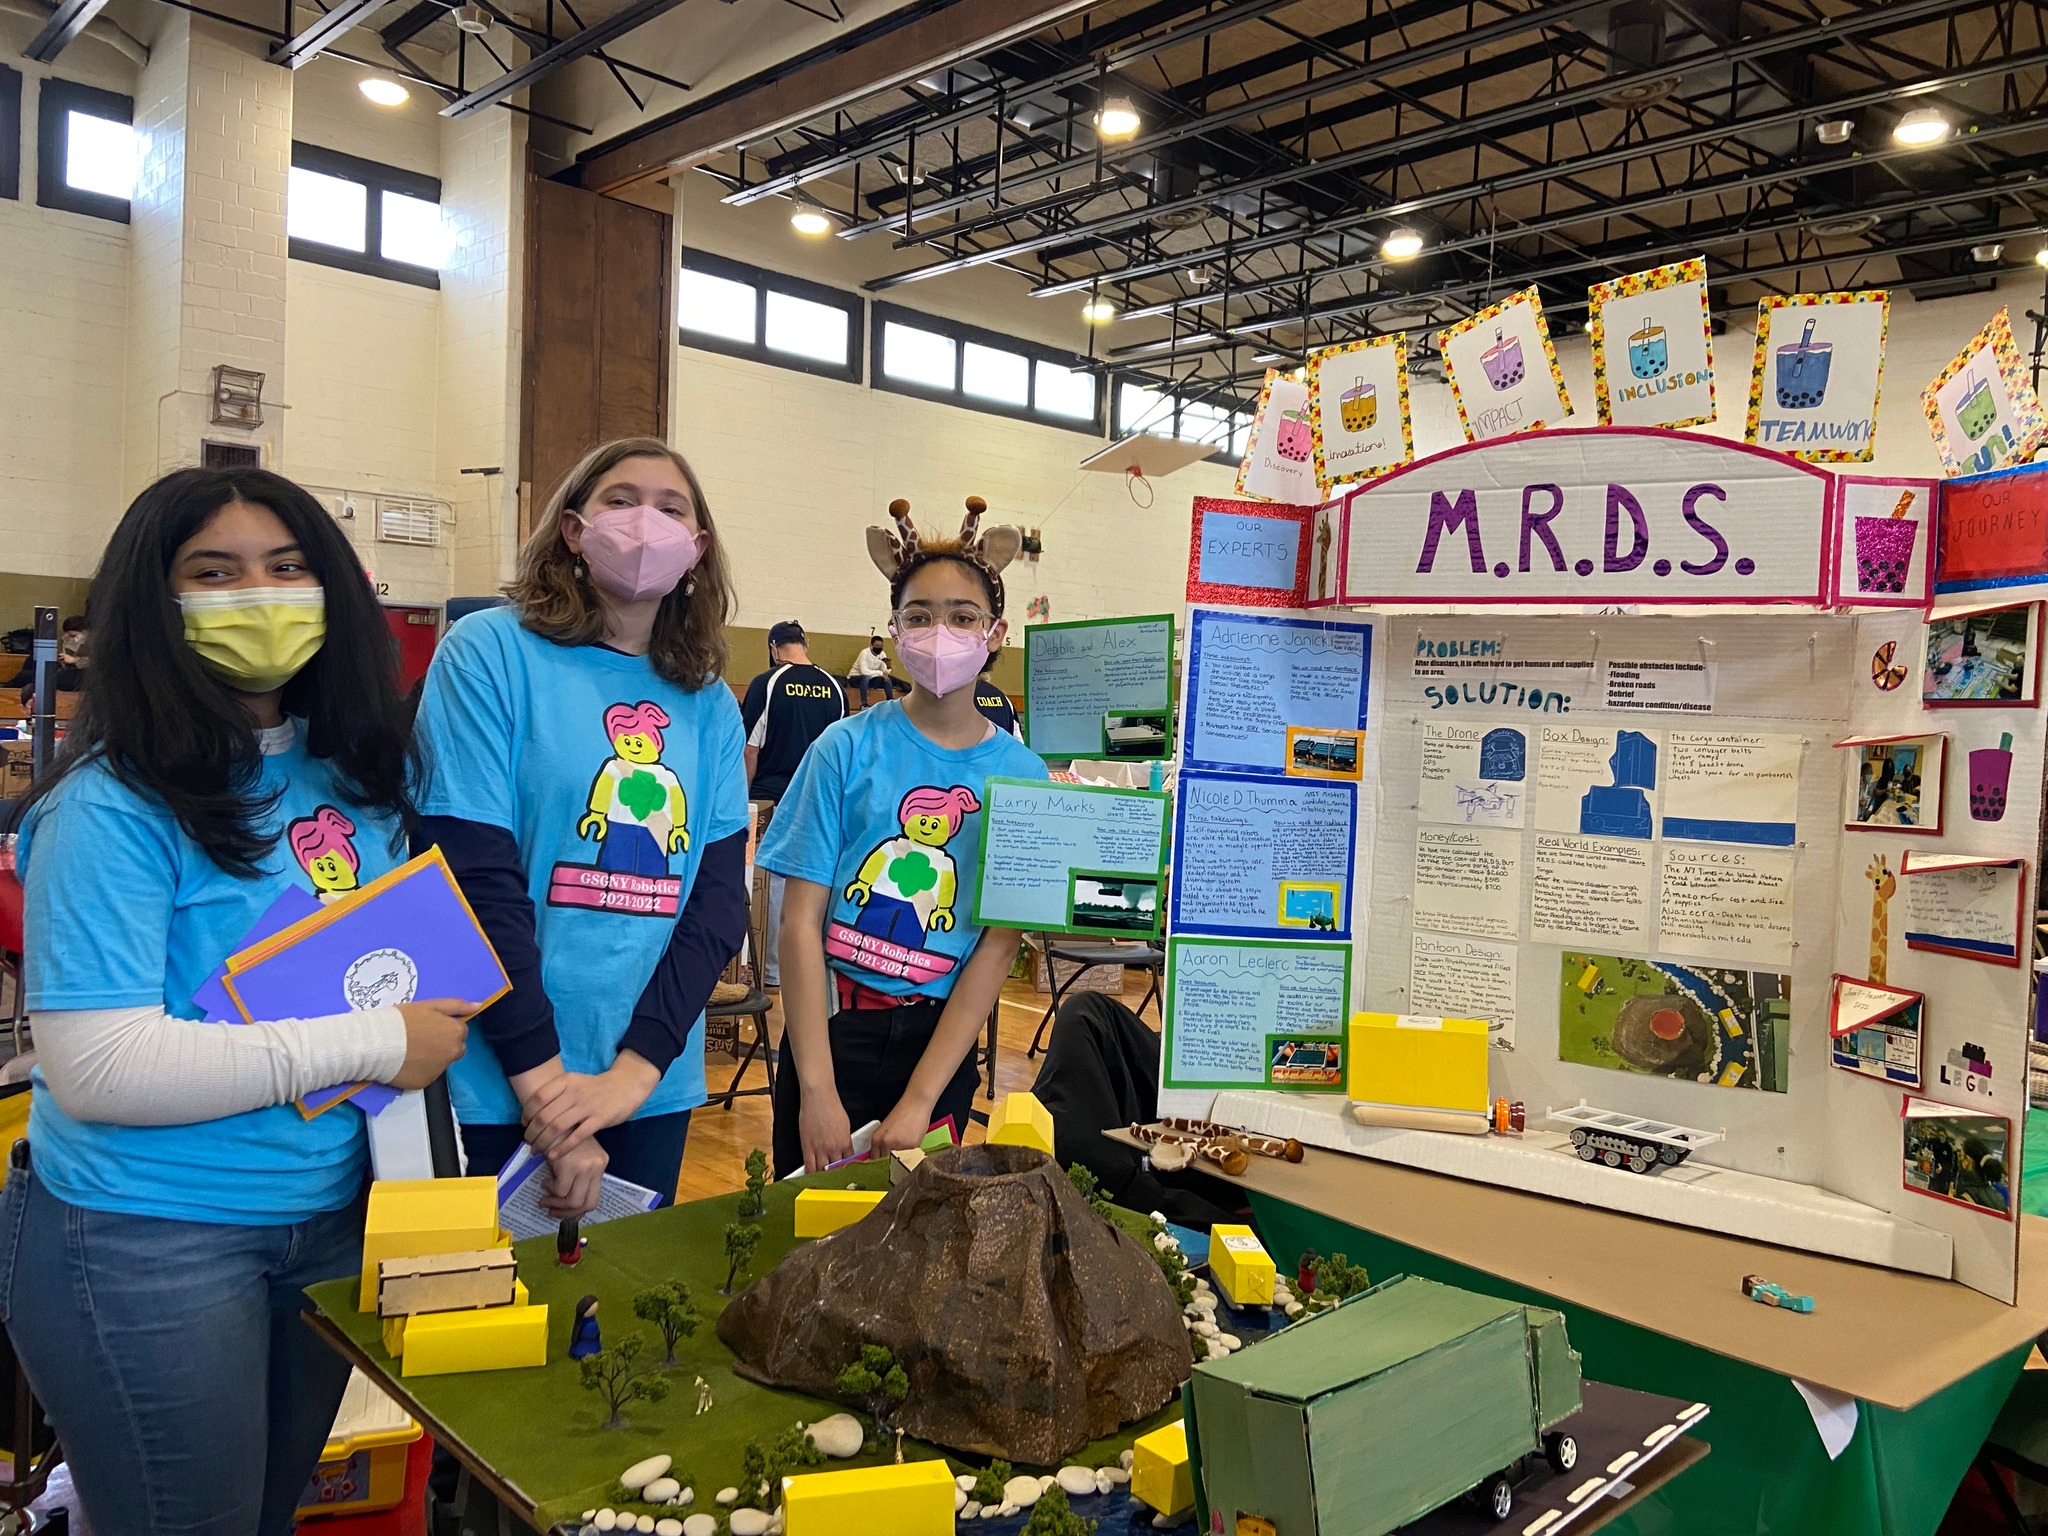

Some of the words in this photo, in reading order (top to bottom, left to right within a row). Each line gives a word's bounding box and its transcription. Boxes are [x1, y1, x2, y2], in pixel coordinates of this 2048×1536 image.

[1618, 369, 1708, 402] INCLUSION
[1472, 397, 1523, 439] IMPACT
[1264, 457, 1303, 478] Discovery
[1983, 491, 2010, 508] OUR
[1236, 521, 1262, 532] OUR
[1416, 483, 1755, 578] M.R.D.S.
[1953, 509, 2041, 542] JOURNEY
[1208, 540, 1288, 560] EXPERTS
[1035, 635, 1075, 657] Debbie
[1081, 641, 1092, 651] and
[1104, 630, 1136, 649] Alex
[1211, 625, 1280, 646] Adrienne
[1284, 632, 1333, 648] Janicki
[1417, 639, 1501, 658] PROBLEM:
[1608, 661, 1638, 669] Possible
[1639, 662, 1674, 670] obstacles
[1608, 671, 1640, 679] -Flooding
[785, 682, 831, 699] COACH
[1424, 682, 1572, 714] SOLUTION:
[976, 696, 1003, 707] COACH
[1606, 700, 1644, 708] -hazardous
[1645, 702, 1712, 711] condition/disease
[1425, 725, 1442, 738] The
[1448, 726, 1480, 739] Drone
[1542, 728, 1568, 741] Box
[1572, 729, 1610, 748] Design:
[1690, 735, 1712, 745] Cargo
[1717, 735, 1764, 744] container:
[993, 790, 1038, 815] Larry
[1047, 796, 1096, 814] Marks
[1191, 787, 1229, 804] Nicole
[1234, 790, 1242, 805] D
[1246, 789, 1298, 807] Thumma
[1211, 815, 1248, 827] takeaways
[1420, 832, 1479, 843] Money/Cost:
[1538, 837, 1559, 846] Real
[1562, 838, 1588, 850] World
[1593, 842, 1641, 856] Examples:
[1669, 849, 1745, 865] Sources:
[1664, 865, 1680, 873] The
[581, 872, 628, 889] GSGNY
[631, 879, 680, 893] Robotics
[599, 892, 660, 909] 2021-2022
[839, 929, 880, 949] GSGNY
[881, 944, 930, 967] Robotics
[1415, 936, 1460, 953] Pontoon
[1465, 943, 1502, 962] Design:
[851, 949, 909, 976] 2021-2022
[1182, 949, 1229, 966] Aaron
[1238, 949, 1289, 971] Leclerc
